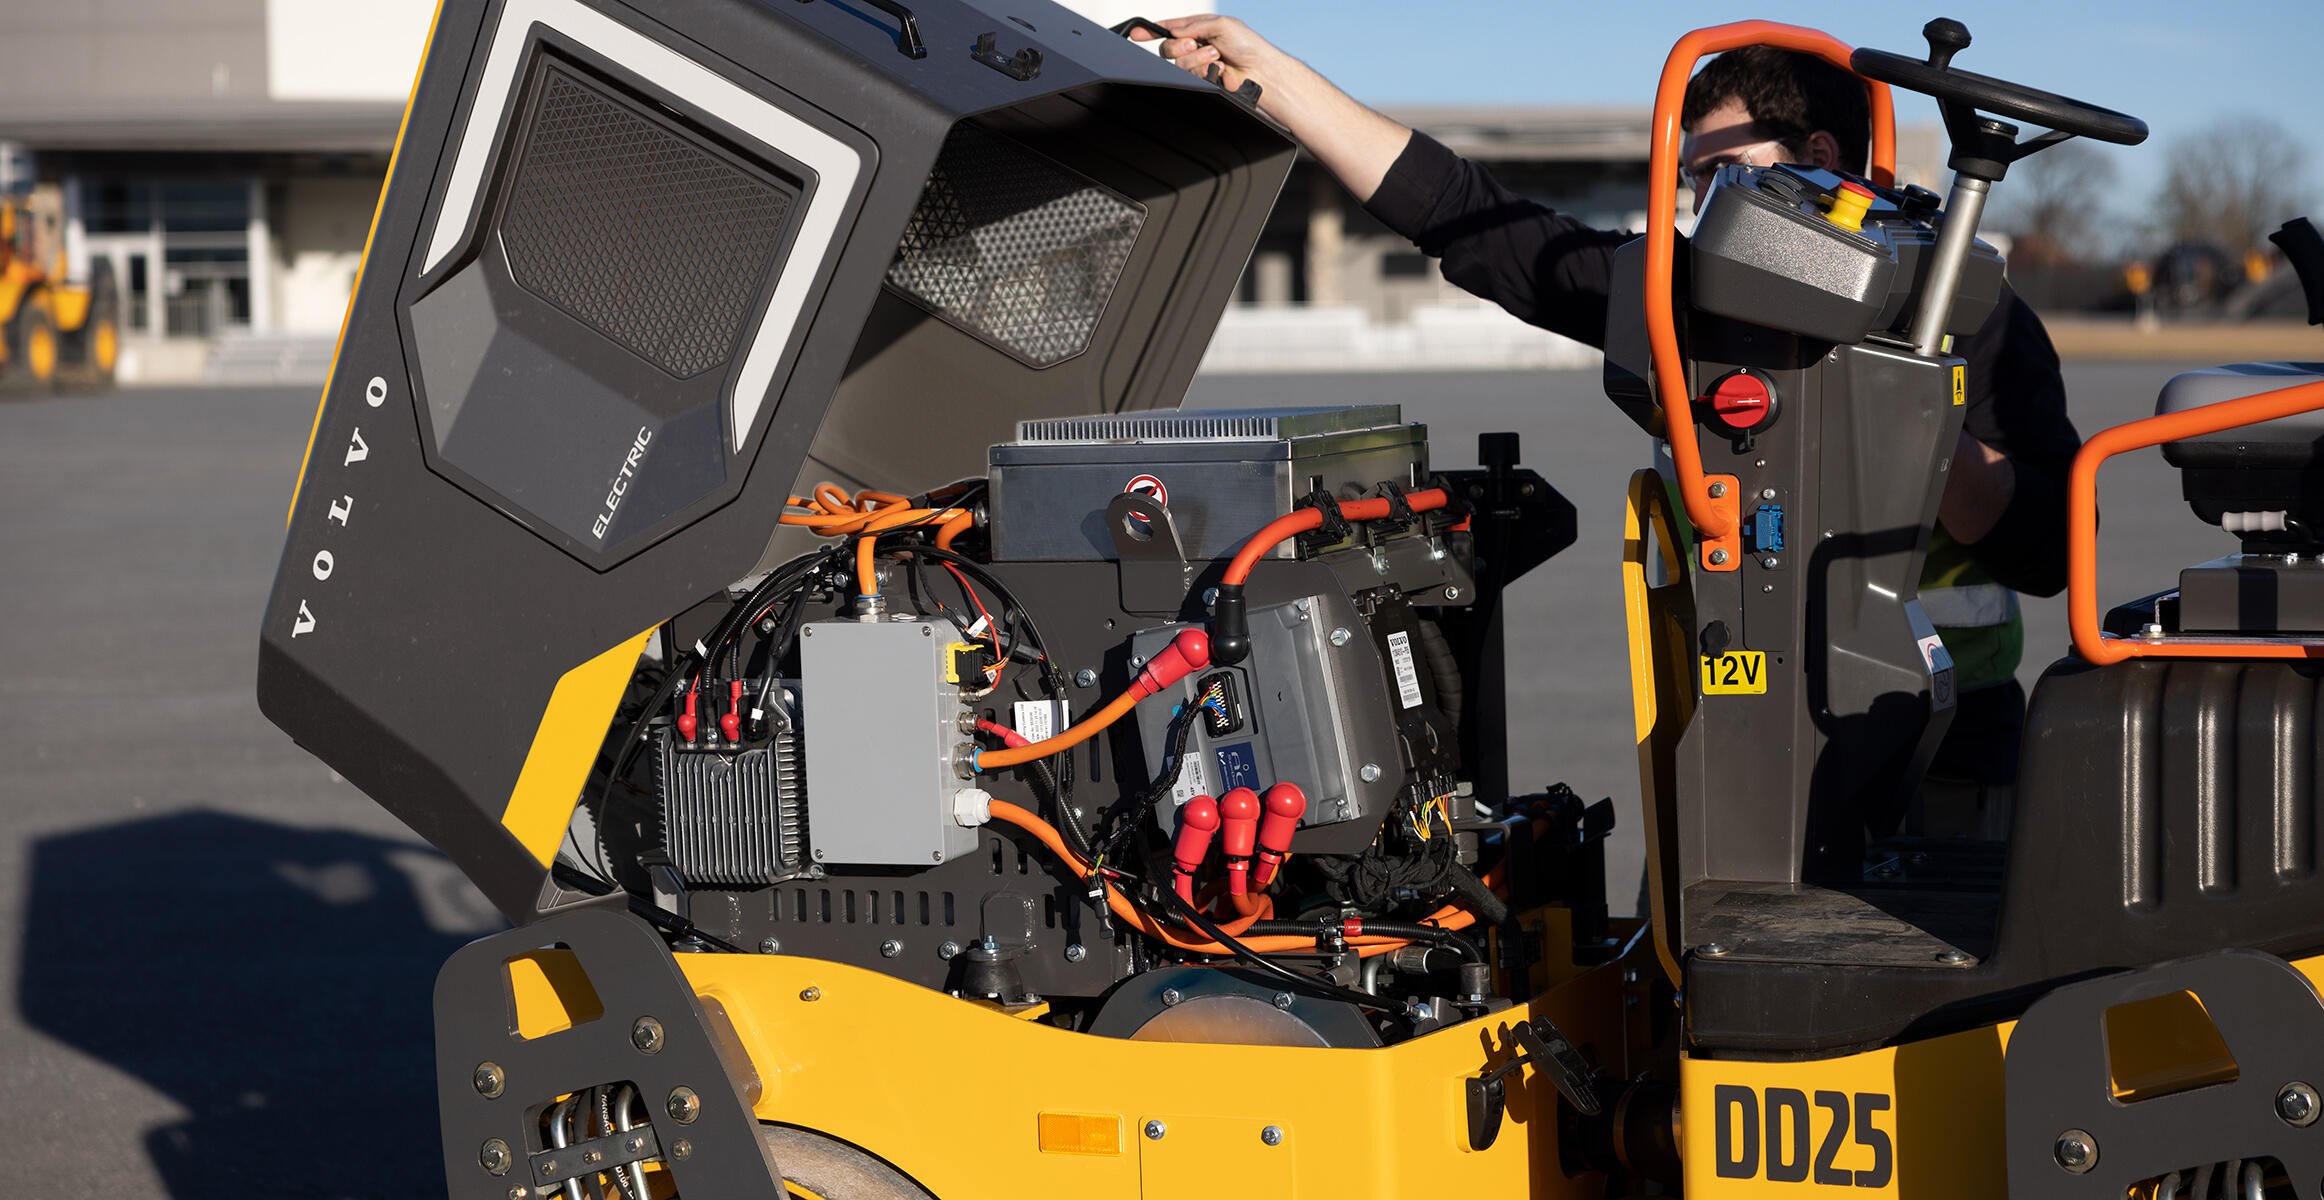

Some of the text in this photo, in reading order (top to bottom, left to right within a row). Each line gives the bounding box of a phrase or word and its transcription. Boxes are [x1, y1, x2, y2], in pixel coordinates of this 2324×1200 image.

[292, 376, 388, 638] VOLVO
[592, 426, 652, 540] ELECTRIC
[1390, 636, 1407, 646] VOLVO
[1704, 655, 1760, 685] 12V
[1715, 1085, 1893, 1189] DD25
